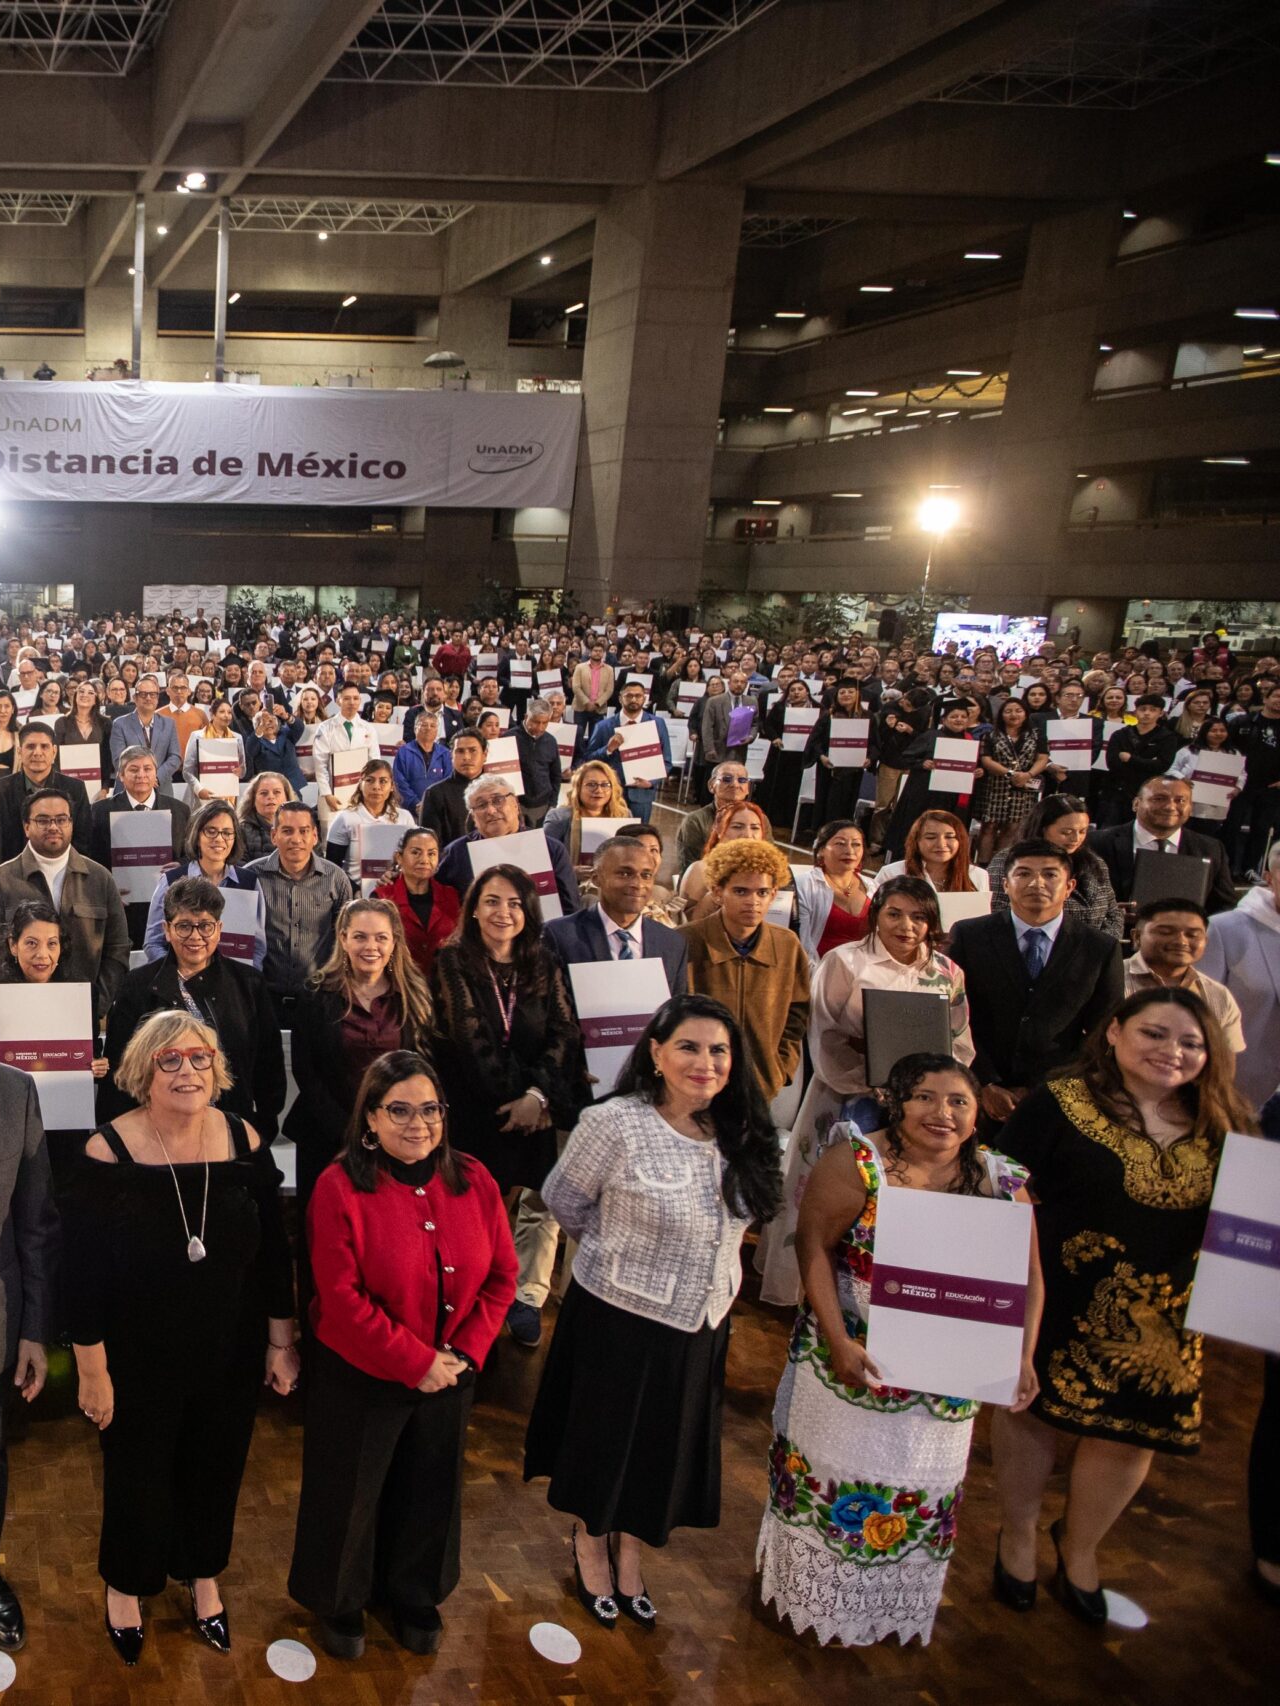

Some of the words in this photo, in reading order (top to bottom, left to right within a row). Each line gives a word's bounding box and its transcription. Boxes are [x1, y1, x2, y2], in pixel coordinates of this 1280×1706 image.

[476, 444, 534, 455] UnADM
[192, 450, 244, 477] de
[257, 451, 408, 480] México
[902, 1288, 937, 1299] MÉXICO
[945, 1291, 985, 1302] EDUCACIÓN
